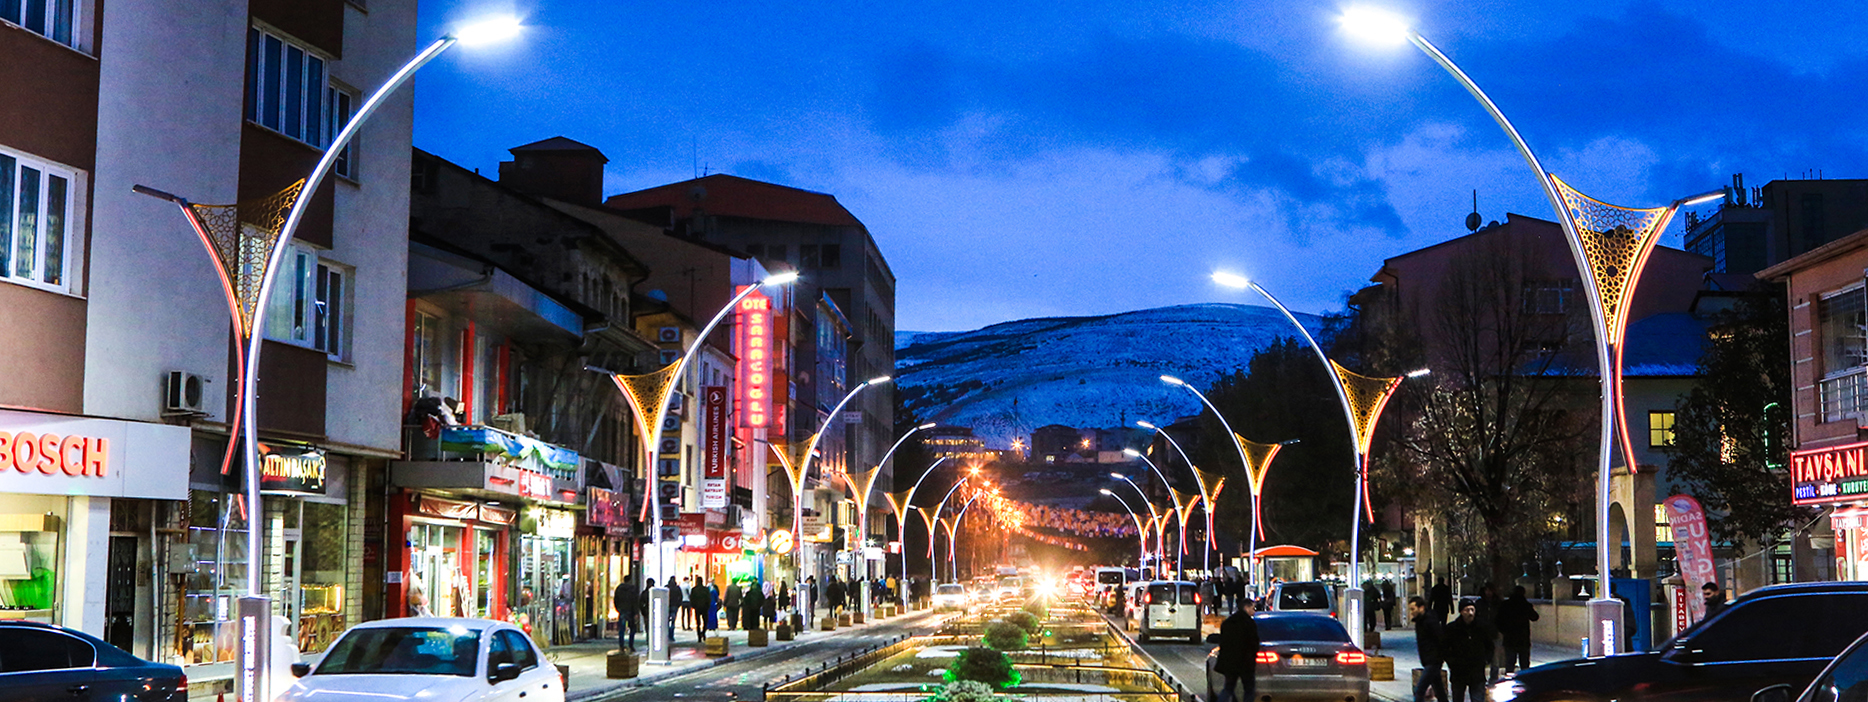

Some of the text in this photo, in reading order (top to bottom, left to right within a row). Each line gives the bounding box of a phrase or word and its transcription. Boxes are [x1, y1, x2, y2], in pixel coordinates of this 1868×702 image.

[0, 431, 110, 477] BOSCH
[711, 406, 720, 474] TURKISH AIRLINES
[263, 457, 291, 477] ALTIN
[1795, 484, 1816, 499] PESTİL
